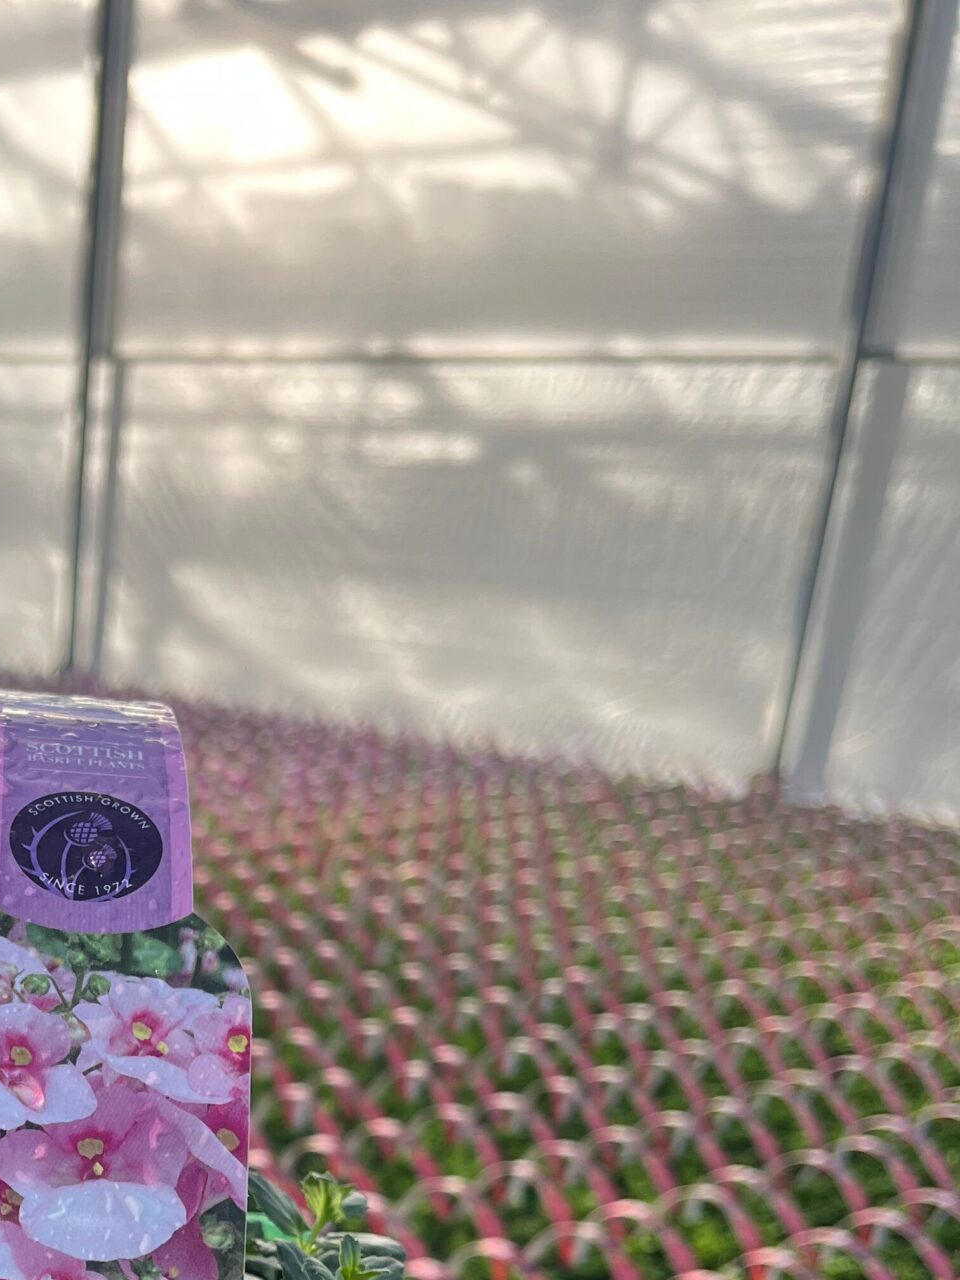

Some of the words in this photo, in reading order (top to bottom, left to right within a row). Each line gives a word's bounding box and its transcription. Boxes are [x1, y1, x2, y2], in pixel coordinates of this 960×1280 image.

[26, 742, 144, 761] SCOTTISH
[89, 759, 145, 770] PLANTS
[28, 795, 93, 816] SCOTTISH
[101, 798, 149, 829] GROWN
[40, 872, 85, 895] SINCE
[95, 878, 132, 895] 1972
